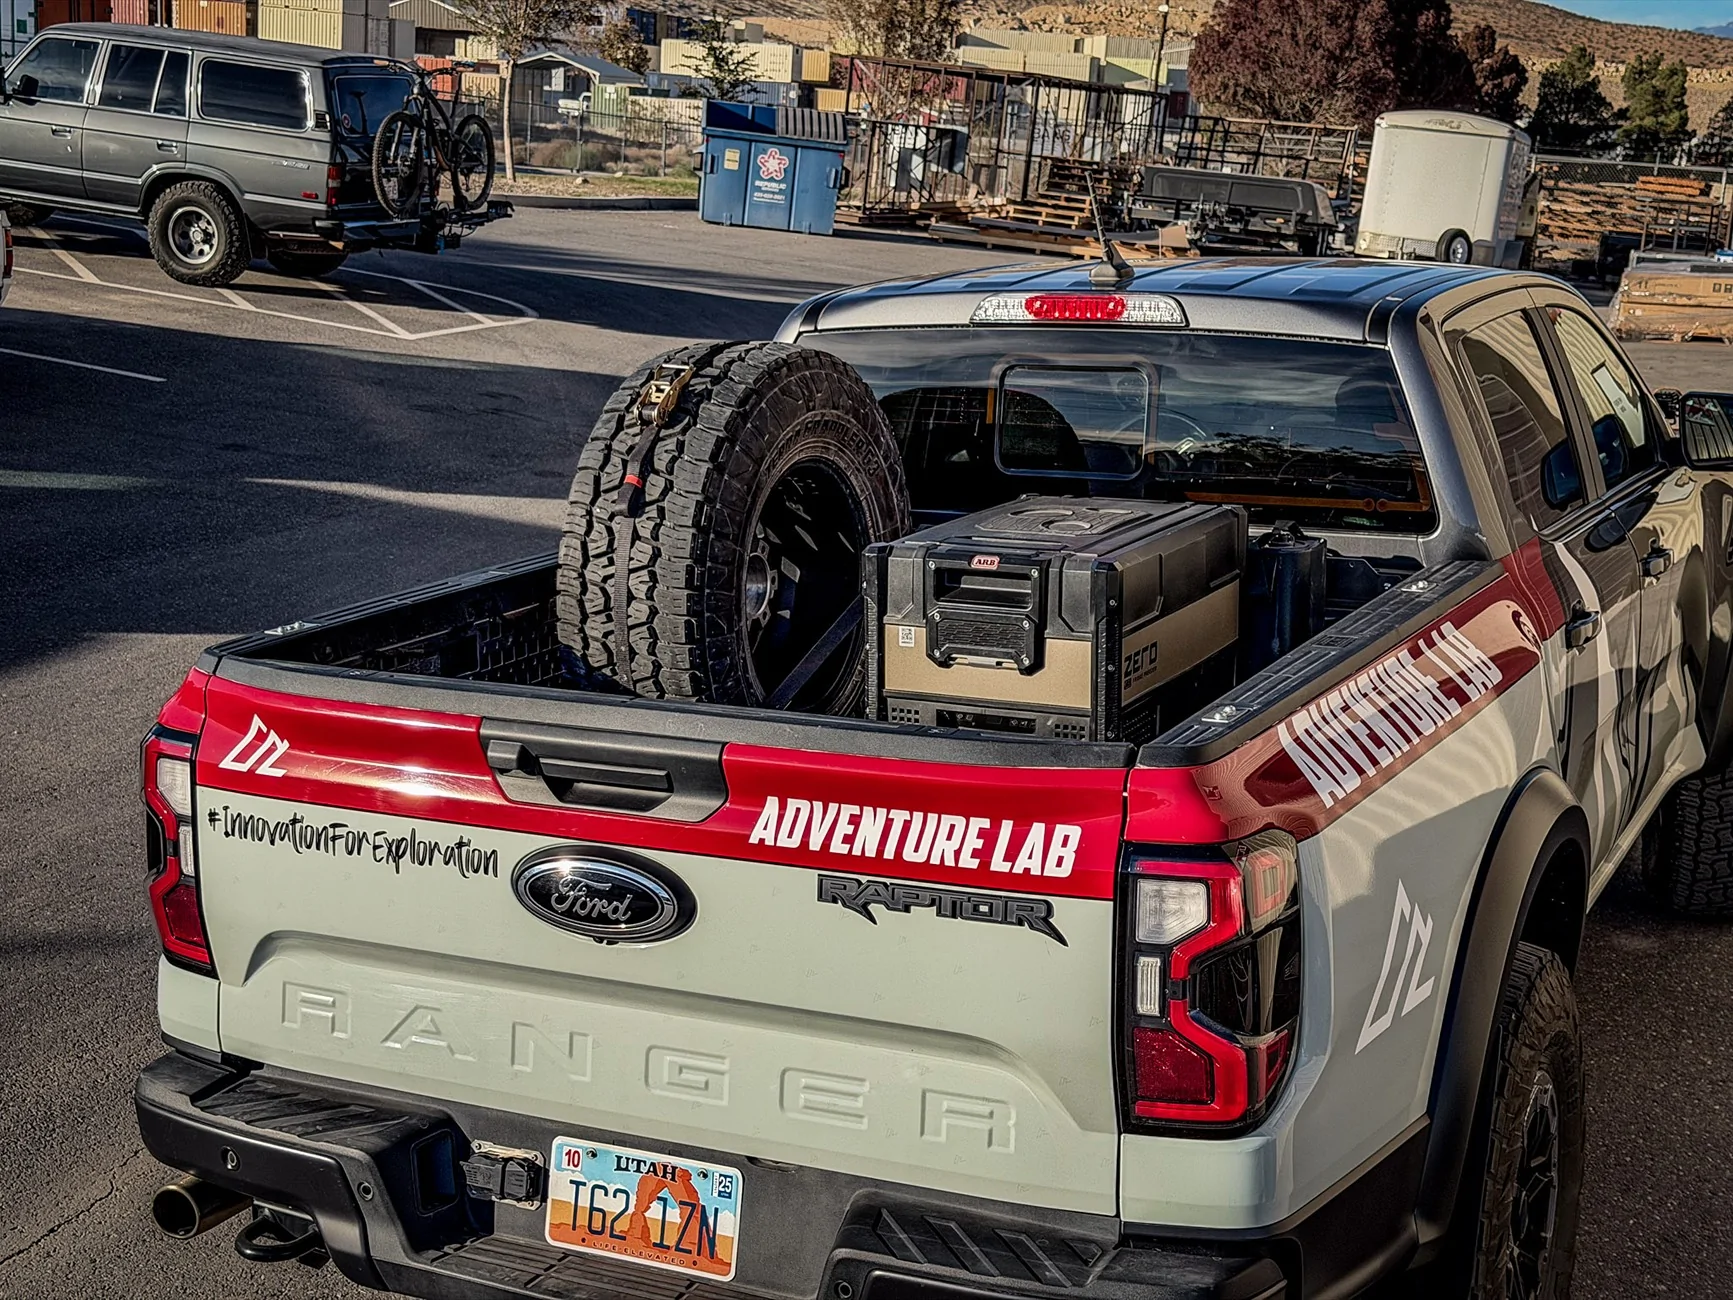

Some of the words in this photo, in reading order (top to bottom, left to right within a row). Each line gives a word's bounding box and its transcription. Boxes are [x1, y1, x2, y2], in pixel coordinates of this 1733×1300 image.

[975, 558, 996, 567] ARB
[1277, 648, 1462, 809] ADVENTURE
[1417, 621, 1503, 702] LAB
[207, 805, 499, 879] #InnovationForExploration
[749, 796, 990, 869] ADVENTURE
[990, 820, 1082, 877] LAB
[550, 874, 634, 922] Ford
[817, 873, 1069, 948] RAPTOR
[282, 980, 1017, 1154] RANGER
[564, 1148, 581, 1168] 10
[614, 1154, 679, 1183] UTAH
[718, 1176, 732, 1193] 25
